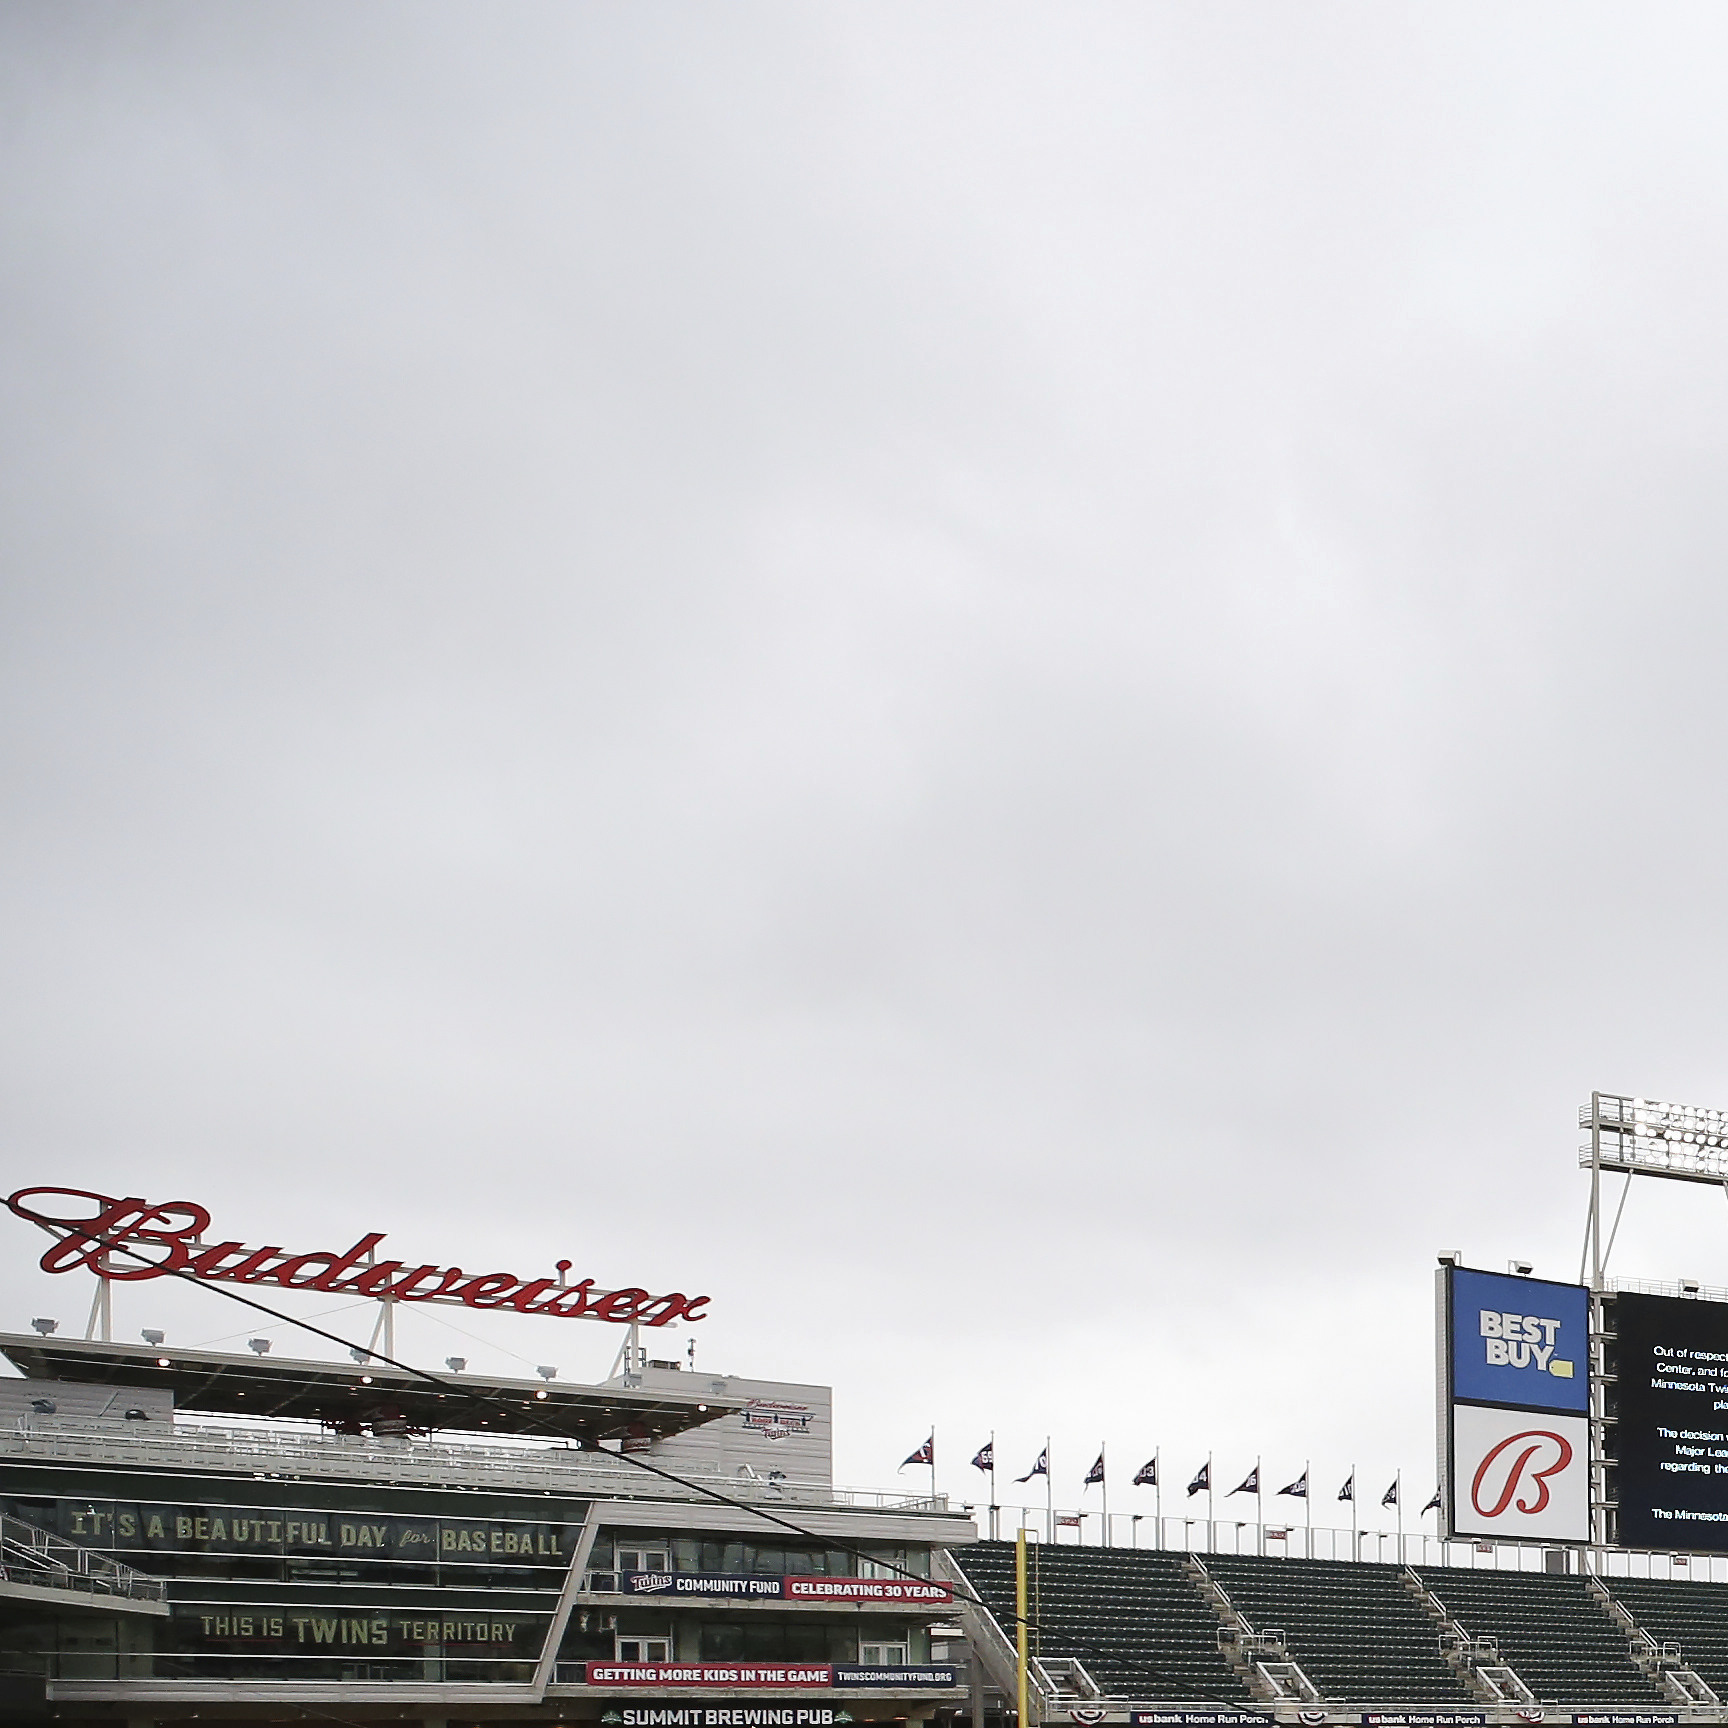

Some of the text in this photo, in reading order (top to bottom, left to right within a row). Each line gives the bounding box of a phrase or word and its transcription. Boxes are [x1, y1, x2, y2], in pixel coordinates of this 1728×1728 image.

[8, 1186, 712, 1327] Budweiser
[1479, 1309, 1561, 1346] BEST
[1486, 1338, 1554, 1371] BUY
[1653, 1345, 1674, 1357] Out
[1676, 1348, 1687, 1357] of
[1689, 1351, 1728, 1362] respect
[1697, 1367, 1717, 1376] and
[1650, 1377, 1705, 1392] Minnesota
[1472, 1430, 1573, 1518] B
[71, 1510, 563, 1555] IT'S A BEAUTIFUL DAY for BASEBALL
[630, 1574, 780, 1594] Twins COMMUNITY FUND
[791, 1582, 947, 1598] CELEBRATING 30 YEARS
[201, 1616, 517, 1644] THIS IS TWINS TERRITORY
[592, 1668, 829, 1682] GETTING MORE KIDS IN THE GAME
[623, 1709, 833, 1726] SUMMIT BREWING PUB
[1409, 1715, 1434, 1724] Home
[1436, 1715, 1454, 1724] Run
[1455, 1715, 1480, 1724] Porch
